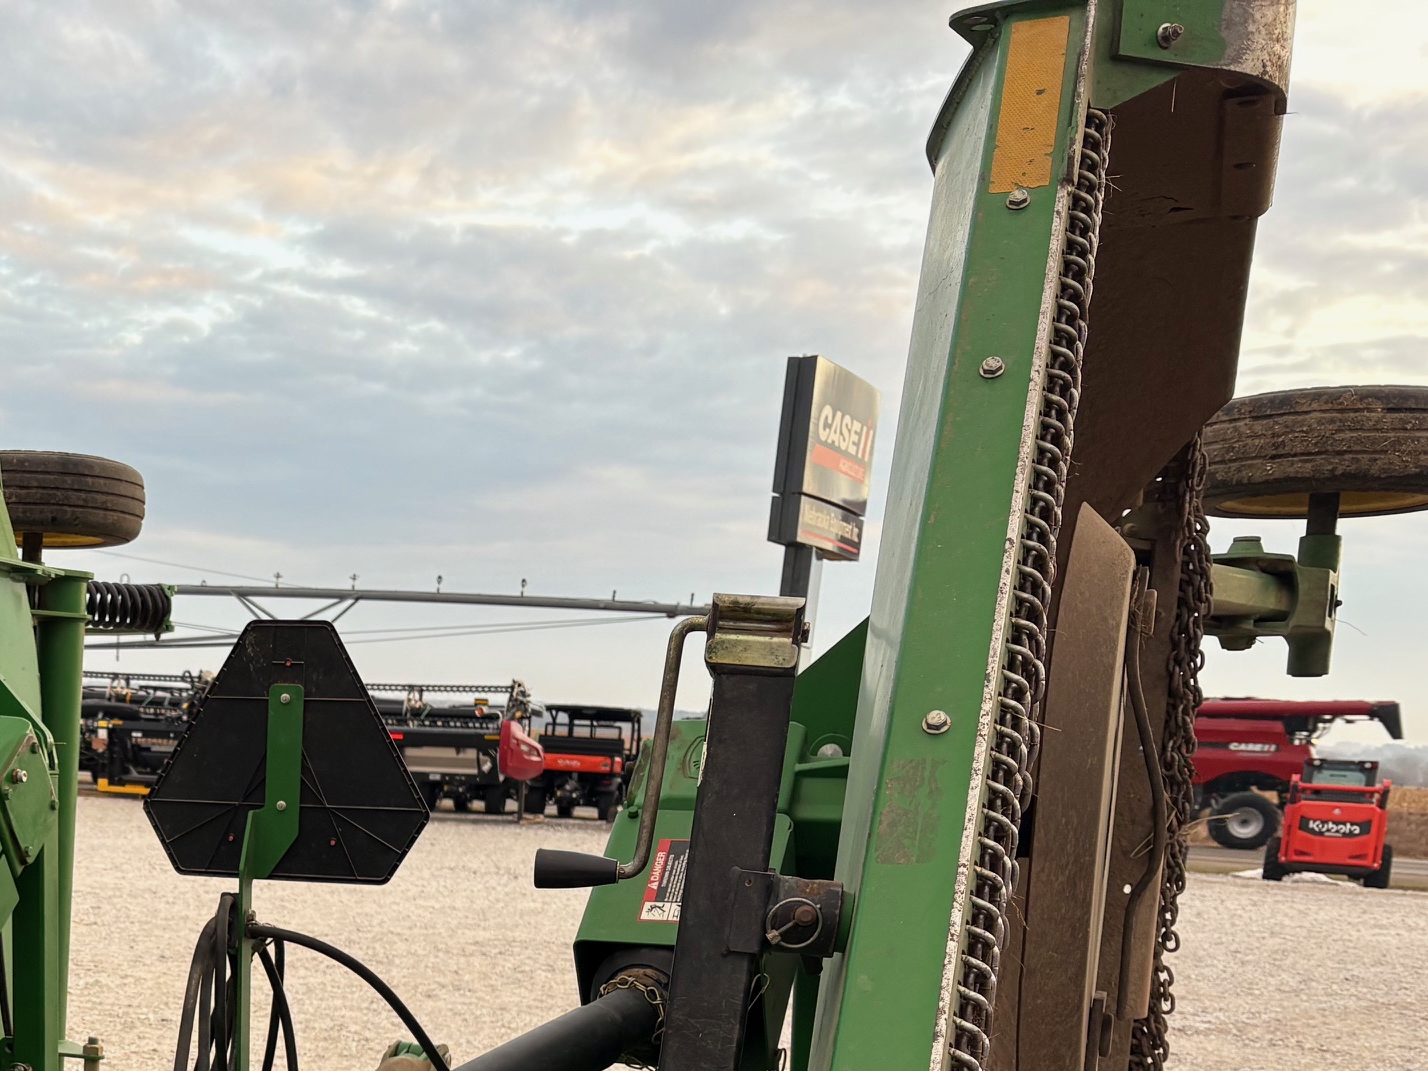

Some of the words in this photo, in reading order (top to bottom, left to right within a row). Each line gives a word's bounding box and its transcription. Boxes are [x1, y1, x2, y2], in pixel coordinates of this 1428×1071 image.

[818, 404, 862, 456] CASE
[1309, 820, 1360, 834] Kubota
[651, 851, 667, 881] DANGER
